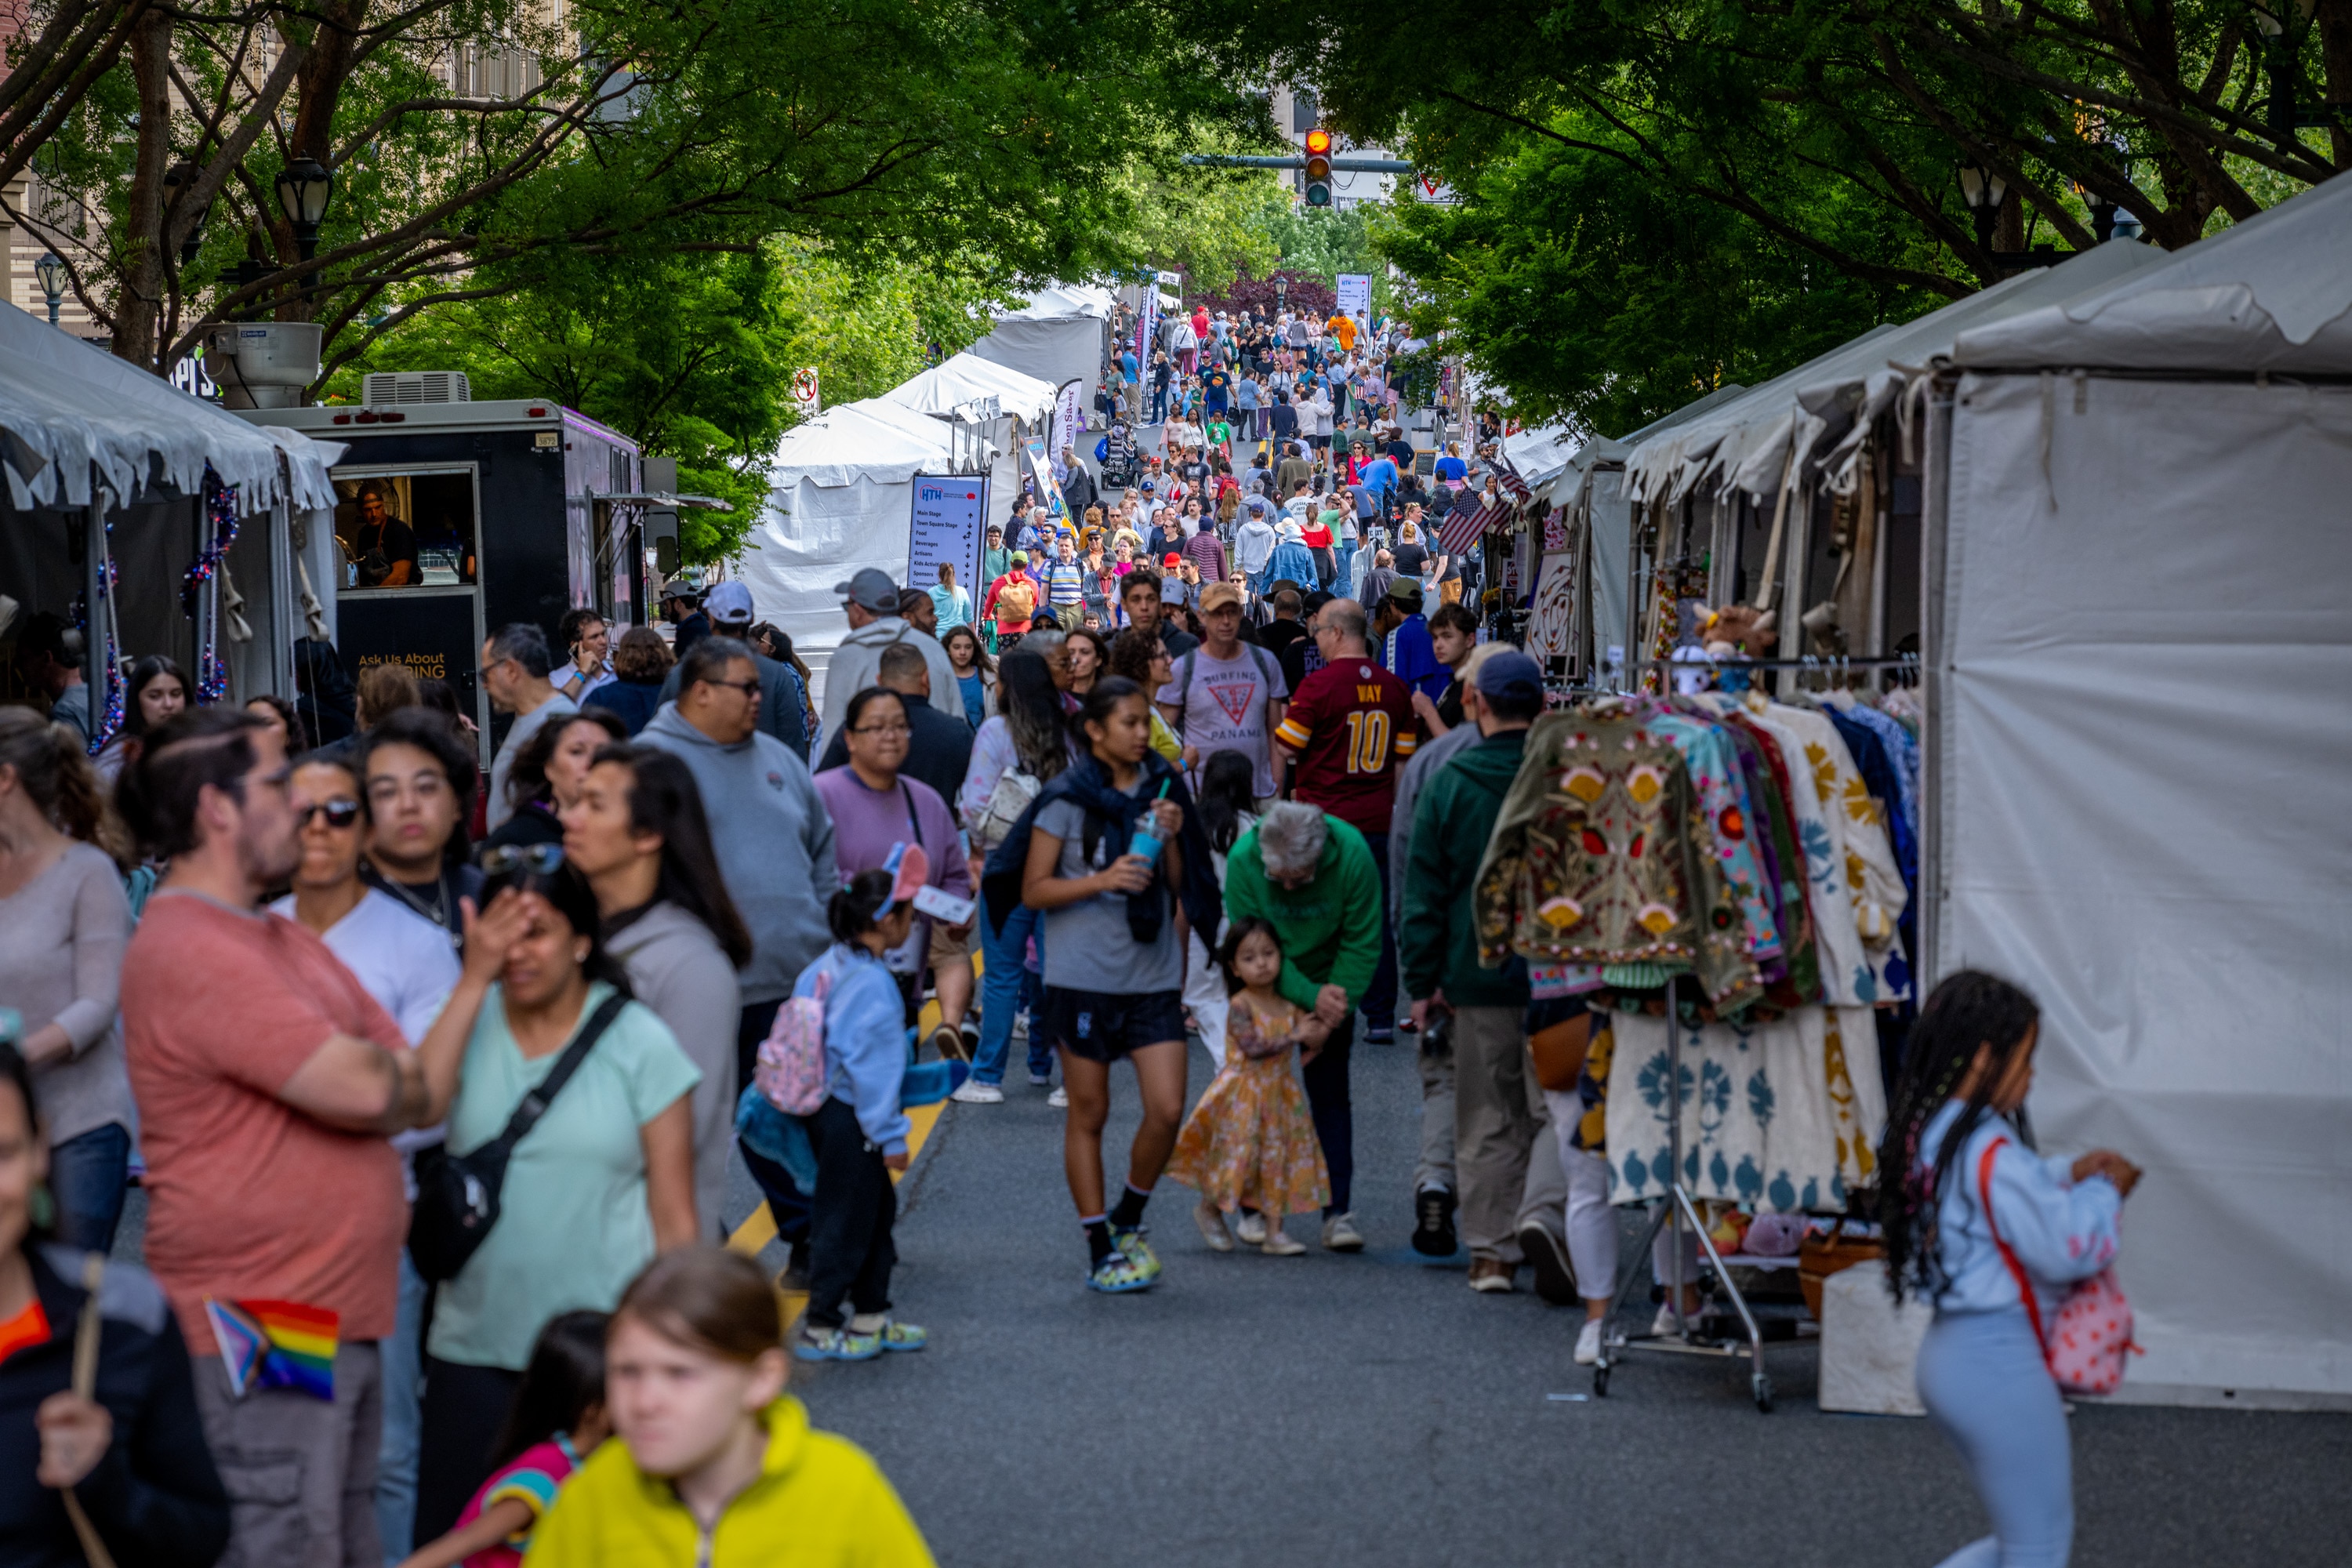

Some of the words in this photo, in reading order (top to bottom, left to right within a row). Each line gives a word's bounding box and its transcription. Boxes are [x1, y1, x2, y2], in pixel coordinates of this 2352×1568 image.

[922, 488, 942, 502] HTH
[359, 654, 382, 666] Ask
[385, 654, 401, 665] Us
[405, 652, 445, 664] About
[1356, 684, 1381, 702] WAY
[1346, 709, 1391, 774] 10
